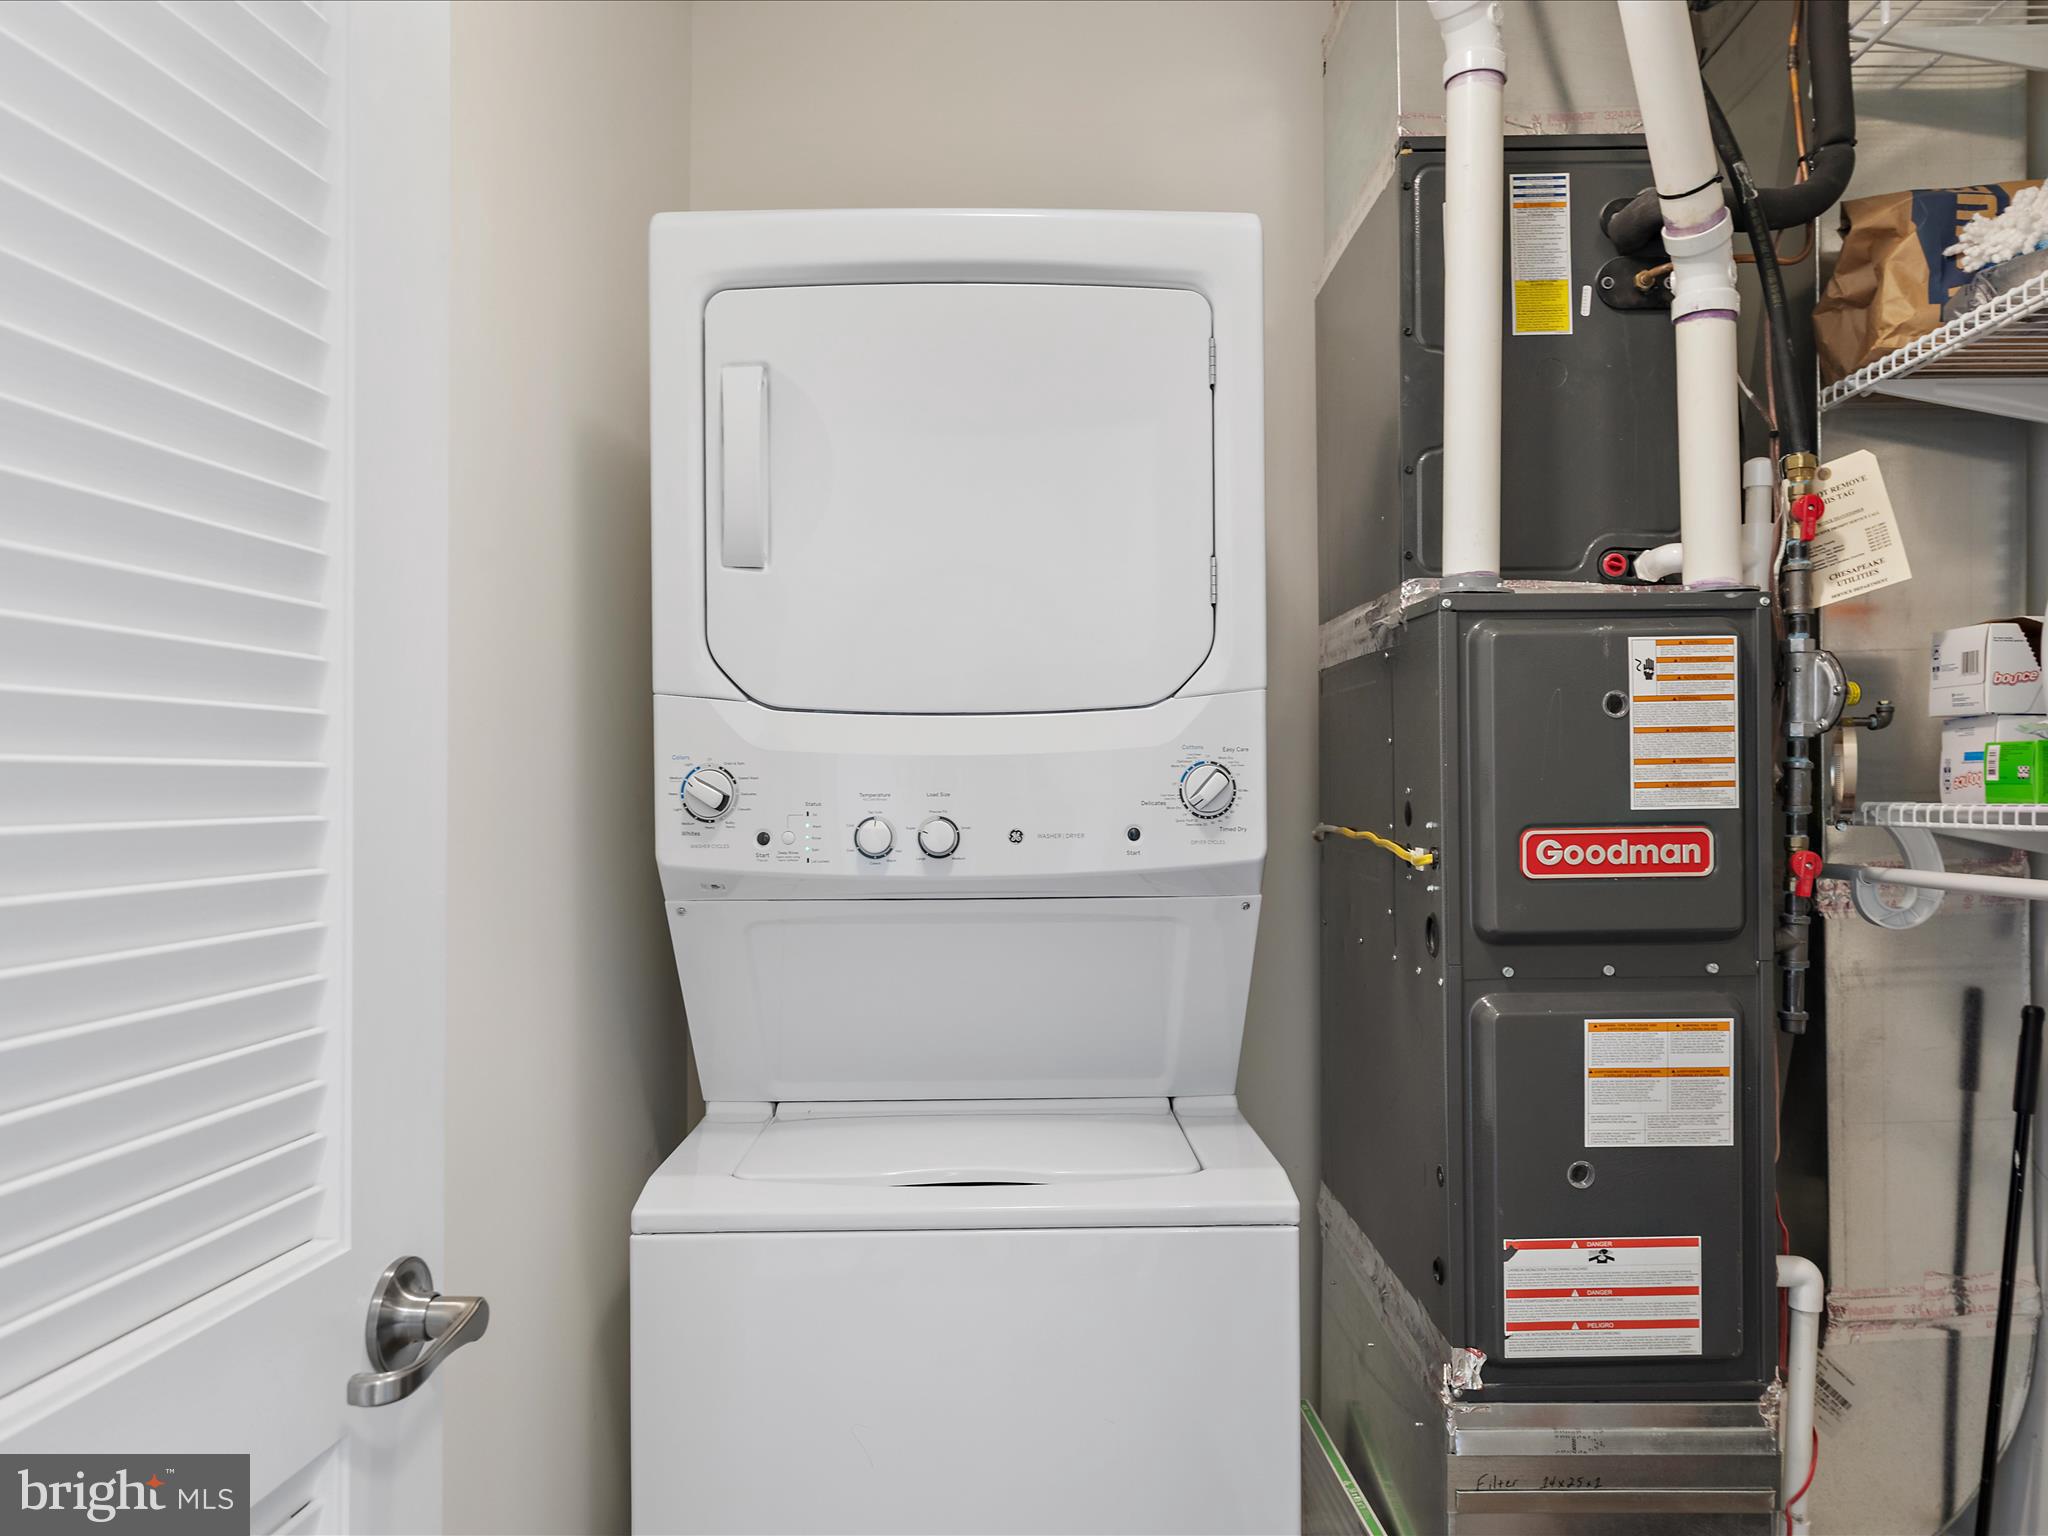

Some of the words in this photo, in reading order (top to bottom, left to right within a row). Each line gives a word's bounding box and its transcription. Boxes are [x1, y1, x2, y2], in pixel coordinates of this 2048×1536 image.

[1830, 475, 1868, 493] REMOVE
[1838, 488, 1856, 500] TAG
[1828, 557, 1886, 581] CHESAPEAKE
[1836, 568, 1881, 587] UTILITIES
[1992, 670, 2040, 686] bounce
[859, 791, 891, 799] Temperature
[1536, 839, 1701, 866] Goodman
[1476, 1474, 1520, 1490] Filter
